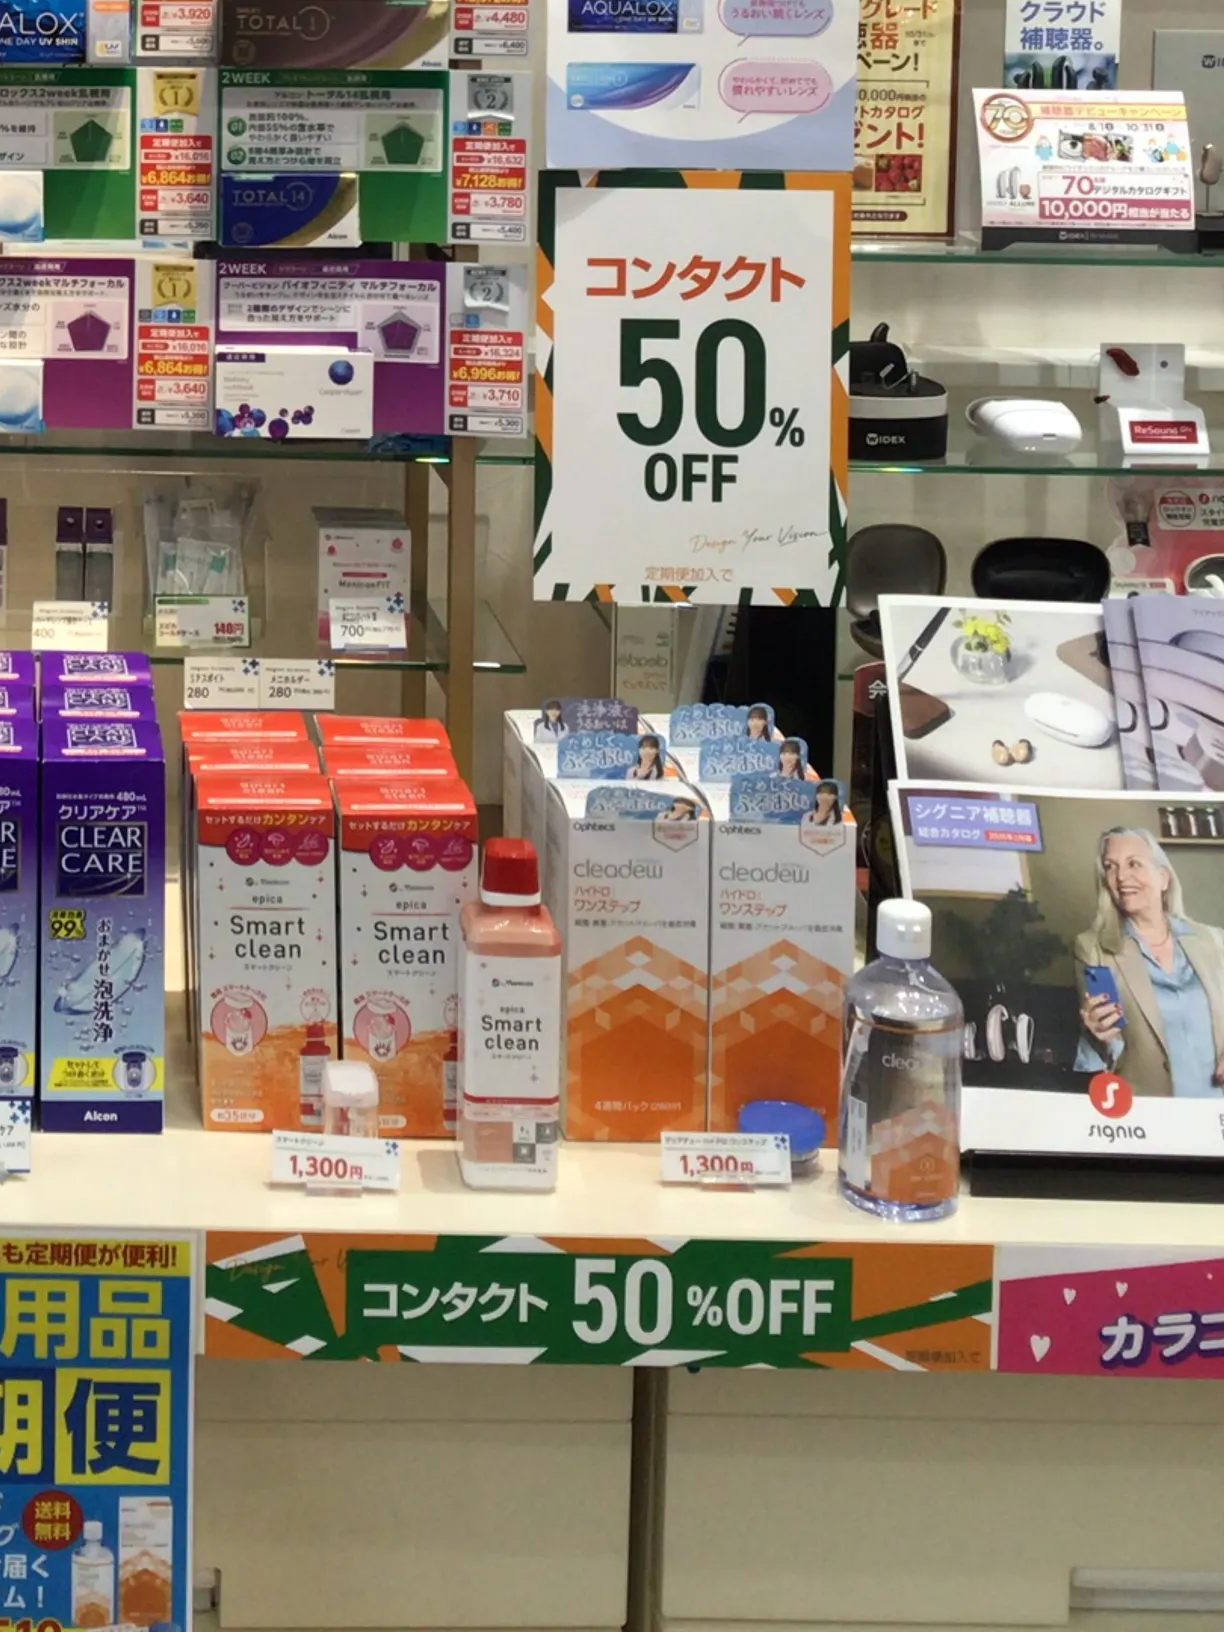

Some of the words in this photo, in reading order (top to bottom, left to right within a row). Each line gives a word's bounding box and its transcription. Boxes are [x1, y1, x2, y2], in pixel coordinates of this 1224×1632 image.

[582, 1, 673, 15] AQUALOX
[1020, 1, 1105, 22] クラウド
[15, 38, 36, 46] DAY
[56, 38, 78, 46] SHIN
[1020, 27, 1103, 51] 補聴器。
[222, 72, 270, 84] 2WEEK
[233, 190, 286, 202] TOTAL
[219, 262, 266, 274] 2WEEK
[586, 255, 806, 303] コンタクト
[644, 453, 739, 502] OFF
[645, 566, 733, 582] 定期便加入で
[342, 625, 364, 637] 700
[188, 688, 208, 698] 280
[269, 687, 291, 697] 280
[206, 814, 325, 826] セットするだけカンタンケア
[915, 803, 1032, 825] シグニア補聴器
[349, 820, 470, 831] セットするだけカンタンケア
[573, 823, 615, 832] Ophtecs
[720, 826, 761, 835] Ophtecs
[61, 827, 142, 848] CLEAR
[61, 853, 142, 873] CARE
[574, 860, 662, 879] cleadew
[719, 863, 809, 883] cleadew
[251, 894, 283, 906] epica
[396, 900, 427, 911] epica
[574, 900, 640, 913] ワンステップ
[719, 904, 787, 916] ワンステップ
[230, 916, 305, 937] Smart
[374, 921, 449, 942] Smart
[235, 940, 302, 960] clean
[378, 945, 445, 966] clean
[499, 1005, 526, 1015] epica
[482, 1015, 542, 1034] Smart
[484, 1033, 539, 1052] clean
[84, 1110, 118, 1121] Alcon
[1088, 1125, 1146, 1143] signia
[363, 1282, 549, 1323] コンタクト
[34, 1502, 71, 1519] 送料
[34, 1522, 71, 1540] 無料
